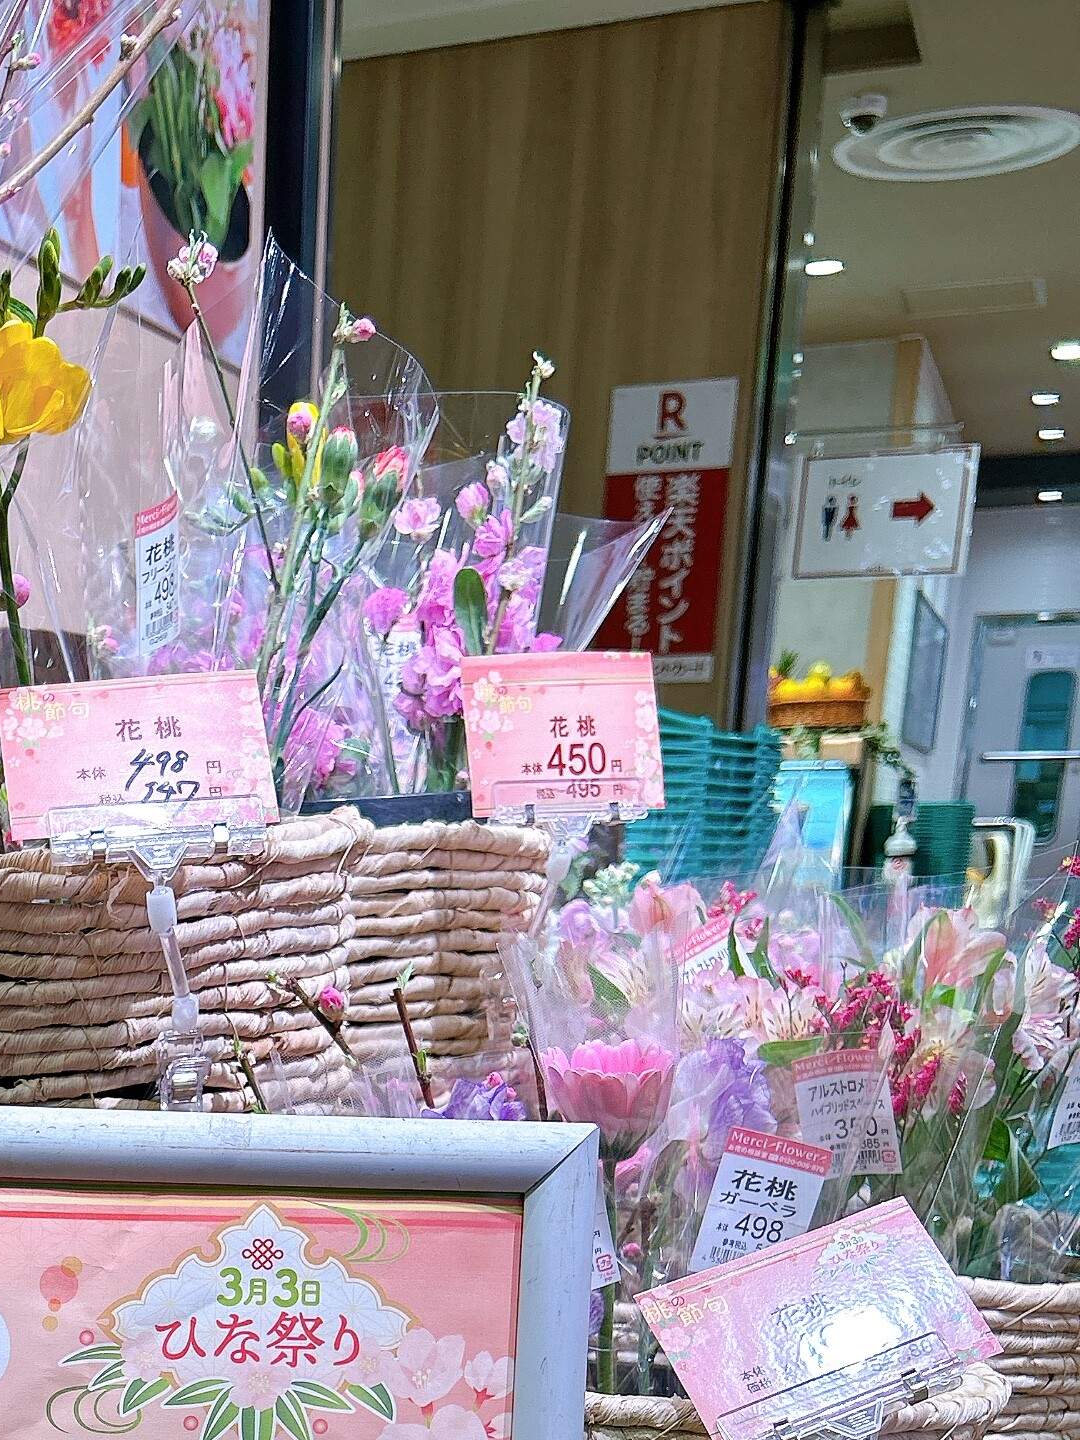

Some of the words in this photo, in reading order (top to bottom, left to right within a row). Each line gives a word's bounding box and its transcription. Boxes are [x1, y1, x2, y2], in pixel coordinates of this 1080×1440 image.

[635, 441, 704, 466] POINT
[145, 533, 175, 566] 花桃
[657, 472, 701, 654] 楽天ポイント
[16, 692, 55, 711] 桃の
[43, 700, 89, 721] 節句
[115, 716, 182, 743] 花桃
[549, 715, 596, 738] 花桃
[76, 767, 107, 781] 本体
[206, 760, 222, 775] 円
[521, 763, 543, 775] 本体
[546, 742, 606, 776] 450
[611, 759, 623, 773] 円
[566, 779, 602, 798] 495
[731, 1130, 768, 1149] Merci
[774, 1141, 821, 1162] Flower
[731, 1169, 799, 1201] 花桃
[719, 1191, 797, 1218] ガーベラ
[734, 1213, 784, 1243] 498
[217, 1267, 320, 1308] 3月3日
[643, 1295, 685, 1324] 桃の
[677, 1295, 729, 1326] 節句
[155, 1311, 361, 1368] ひな祭り
